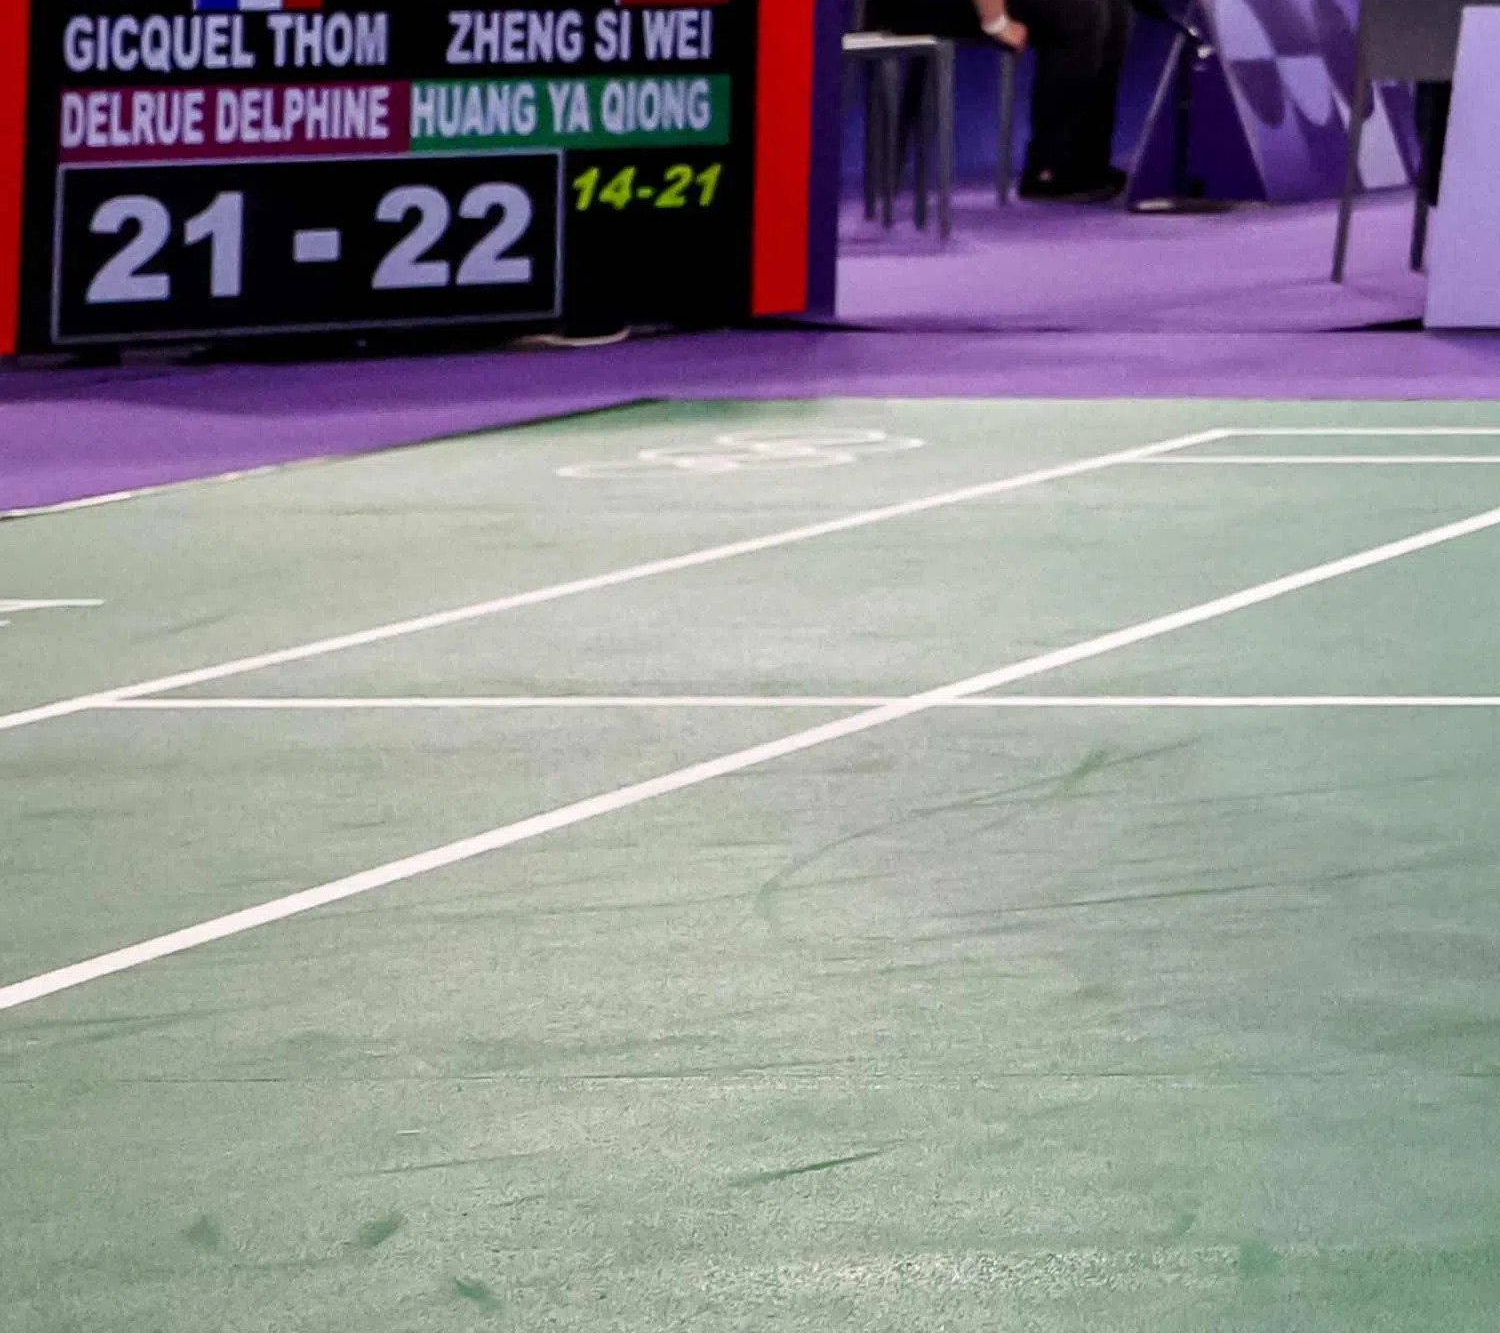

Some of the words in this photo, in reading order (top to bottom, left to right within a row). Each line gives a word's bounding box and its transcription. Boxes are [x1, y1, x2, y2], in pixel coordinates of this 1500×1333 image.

[63, 14, 255, 73] GICQUEL
[267, 11, 388, 67] THOM
[446, 9, 584, 64] ZHENG
[595, 9, 631, 62] SI
[642, 8, 713, 61] WEI
[61, 89, 205, 148] DELRUE
[215, 85, 390, 144] DELPHINE
[410, 83, 538, 138] HUANG
[548, 82, 592, 134] YA
[602, 78, 713, 134] QIONG
[572, 163, 722, 212] 14-21
[86, 190, 243, 305] 21
[370, 181, 534, 290] 22
